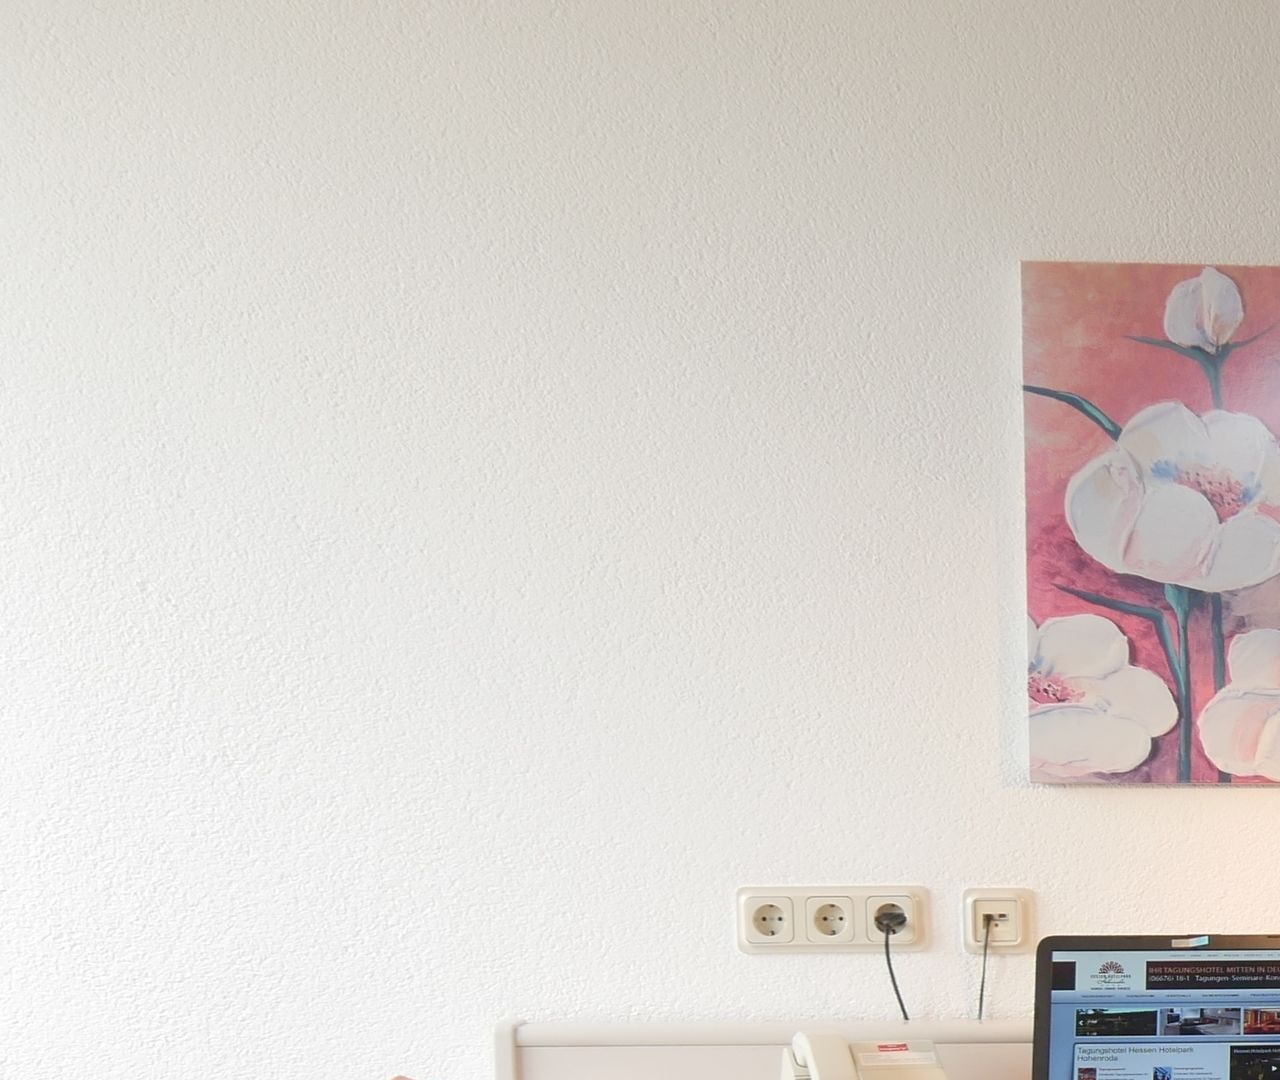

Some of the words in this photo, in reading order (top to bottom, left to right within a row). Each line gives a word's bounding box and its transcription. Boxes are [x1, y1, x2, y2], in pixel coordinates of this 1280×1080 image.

[1164, 966, 1225, 974] TAGUNGSHOTEL
[1226, 966, 1255, 974] MITTEN
[1078, 1047, 1127, 1055] Tagungshotel
